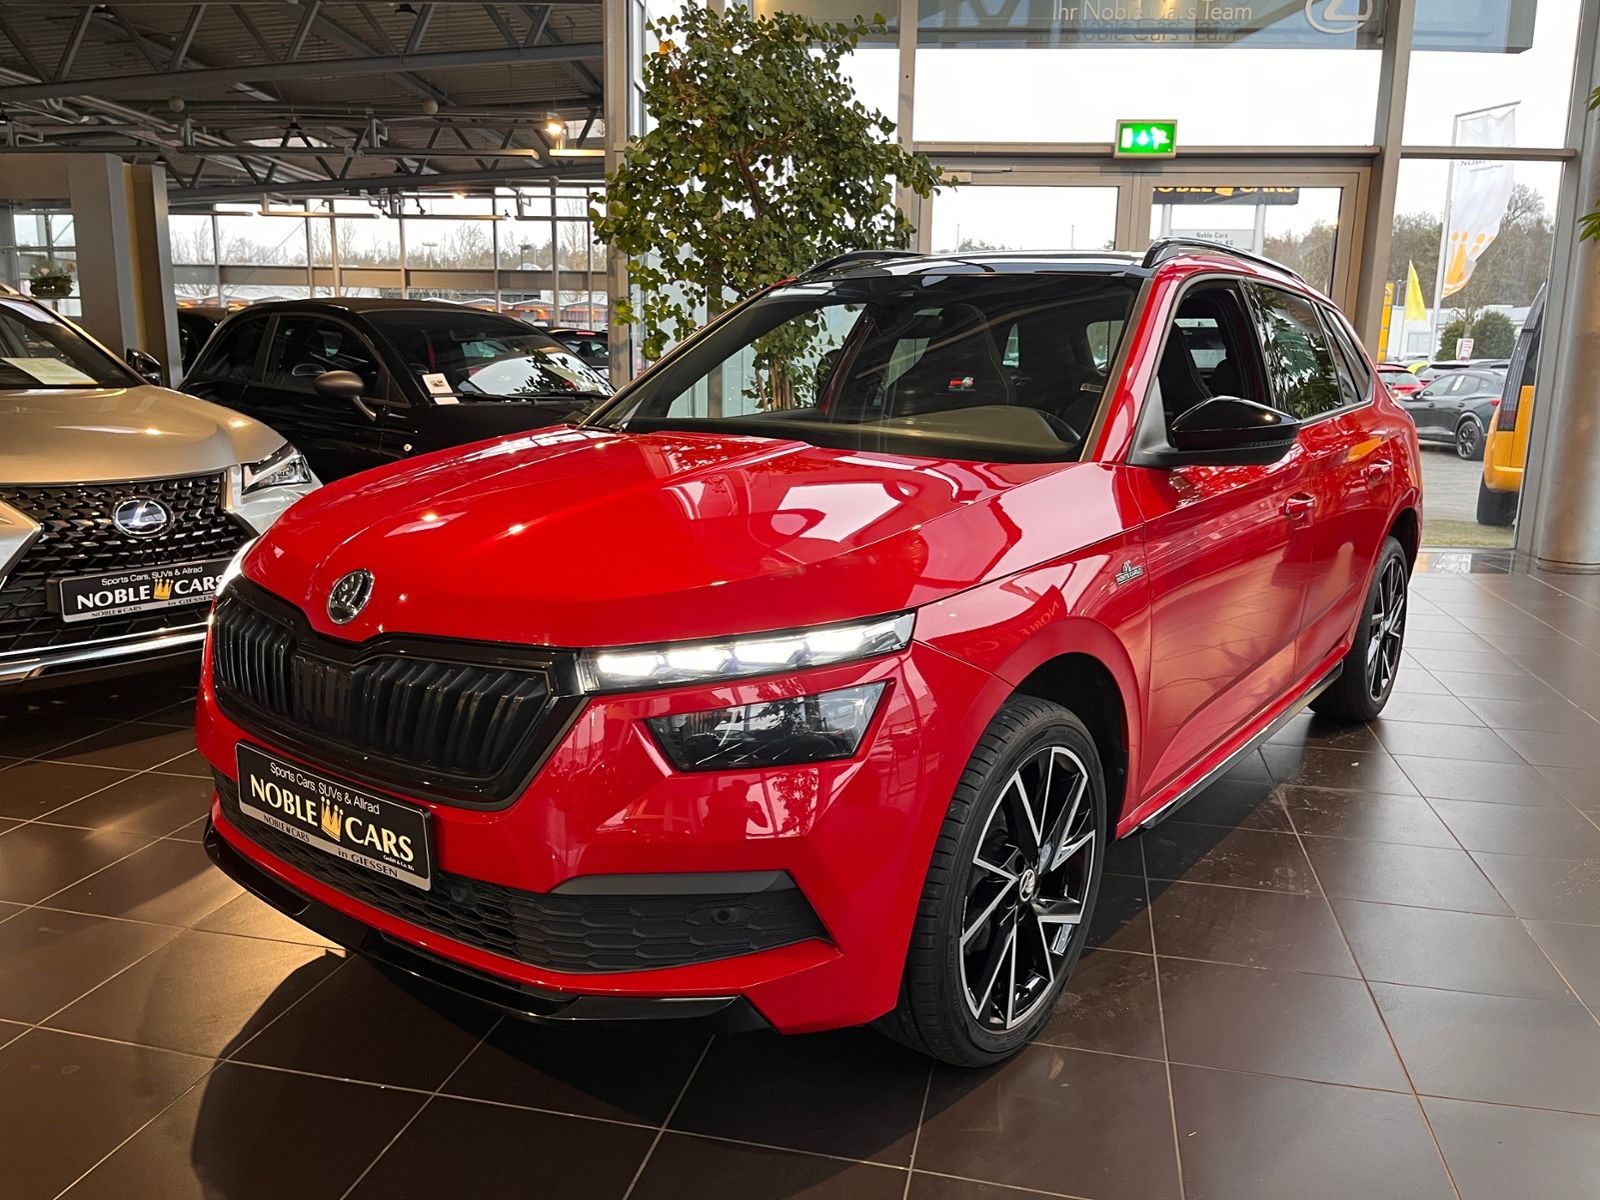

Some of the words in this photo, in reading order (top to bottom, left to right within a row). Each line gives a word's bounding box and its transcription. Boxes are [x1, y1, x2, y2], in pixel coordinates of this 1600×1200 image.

[1083, 0, 1143, 21] Noble
[1204, 0, 1252, 21] Team
[101, 576, 129, 586] Sports
[151, 569, 173, 580] SUVs
[182, 566, 203, 575] Allrad
[77, 585, 150, 610] NOBLE
[270, 761, 296, 783] Sports
[318, 782, 343, 802] SUVs
[344, 792, 353, 806] &
[353, 795, 380, 815] Allrad
[250, 773, 319, 827] NOBLE
[344, 816, 414, 863] CARS
[263, 814, 286, 833] NOBLE
[291, 826, 310, 843] CARS
[337, 847, 348, 859] in
[350, 853, 399, 878] GIESSEN
